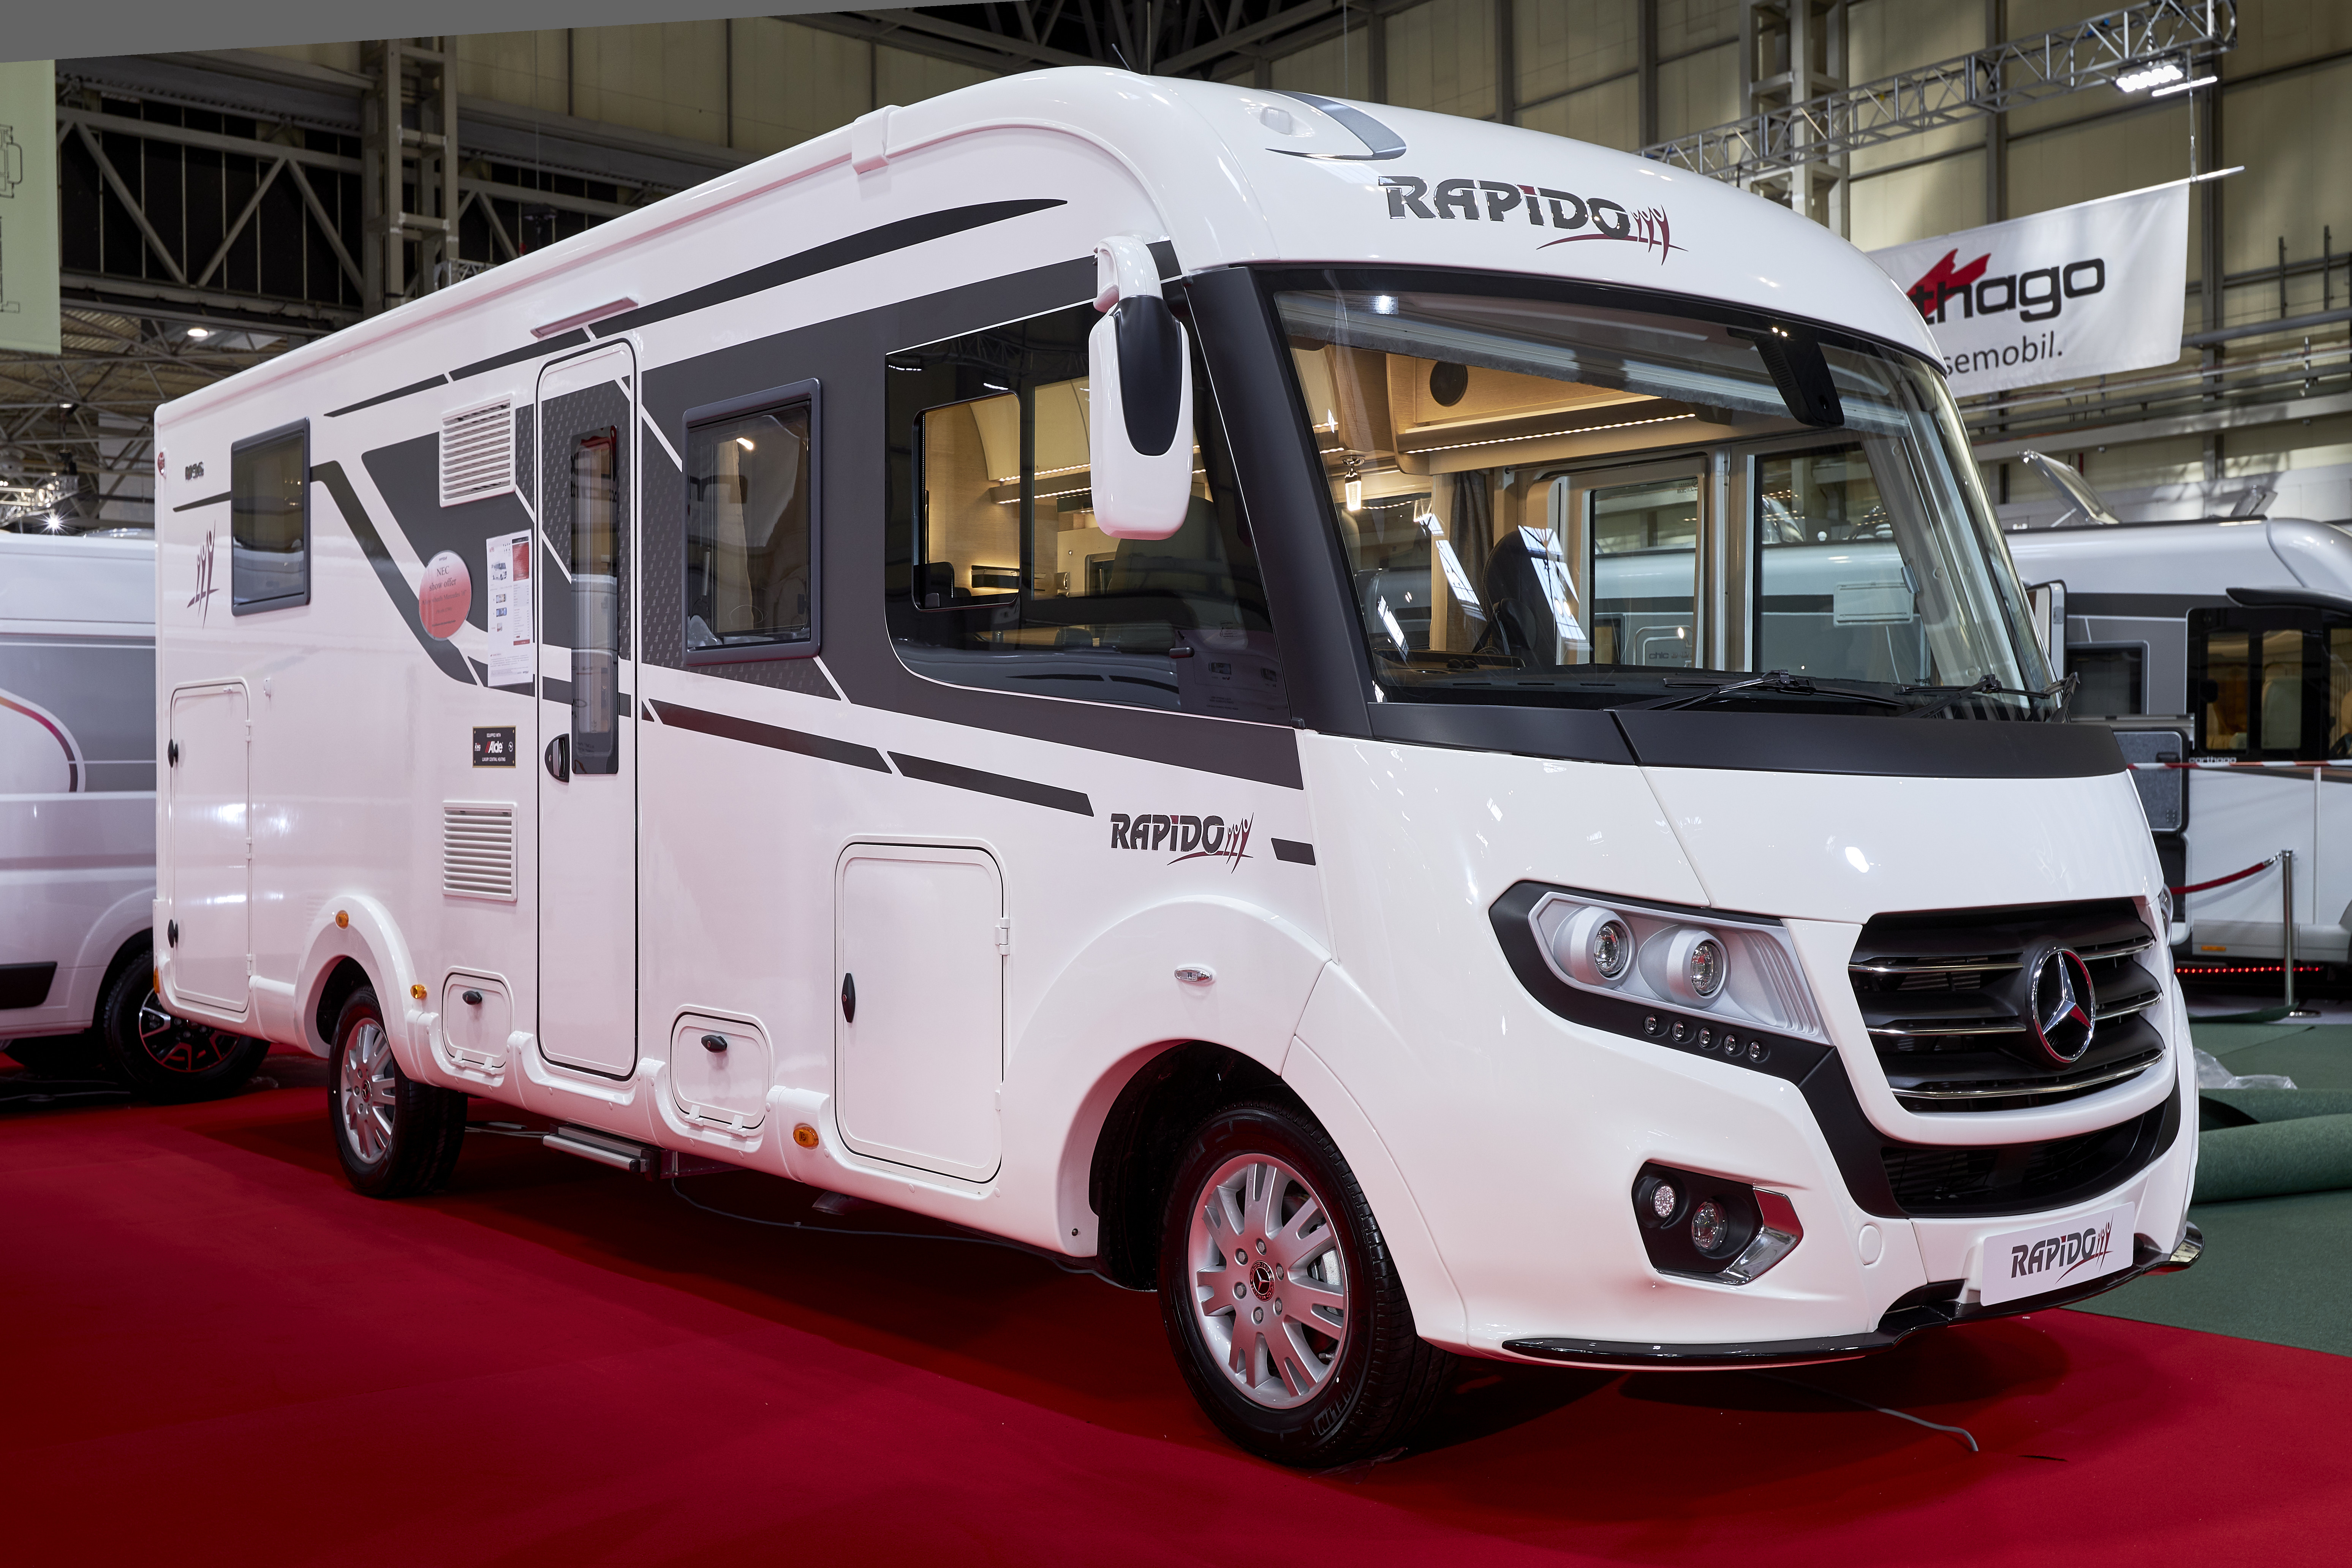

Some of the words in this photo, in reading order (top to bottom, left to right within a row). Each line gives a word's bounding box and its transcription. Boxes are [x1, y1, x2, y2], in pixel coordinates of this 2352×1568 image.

[437, 566, 449, 577] NEC
[429, 582, 443, 591] show
[444, 577, 457, 587] offer
[488, 741, 503, 754] Alde
